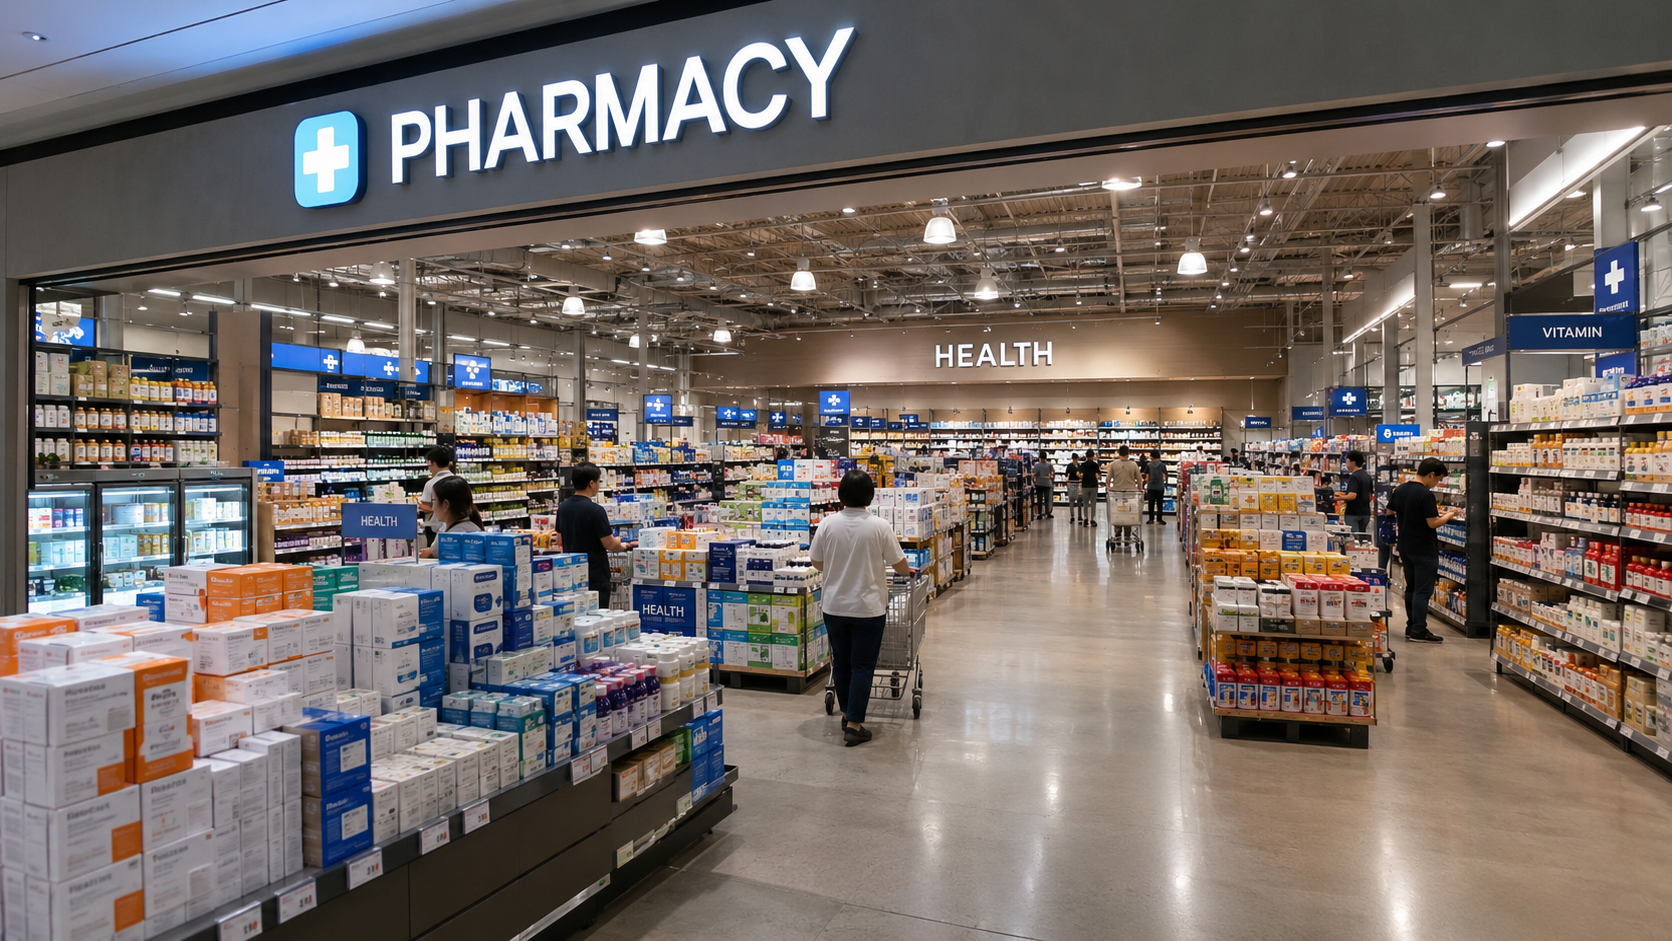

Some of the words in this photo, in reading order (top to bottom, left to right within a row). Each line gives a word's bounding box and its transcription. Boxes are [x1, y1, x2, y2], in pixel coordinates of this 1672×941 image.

[390, 26, 857, 185] PHARMACY
[1542, 326, 1602, 338] VITAMIN
[934, 341, 1053, 368] HEALTH
[360, 515, 398, 527] HEALTH
[642, 604, 684, 617] HEALTH
